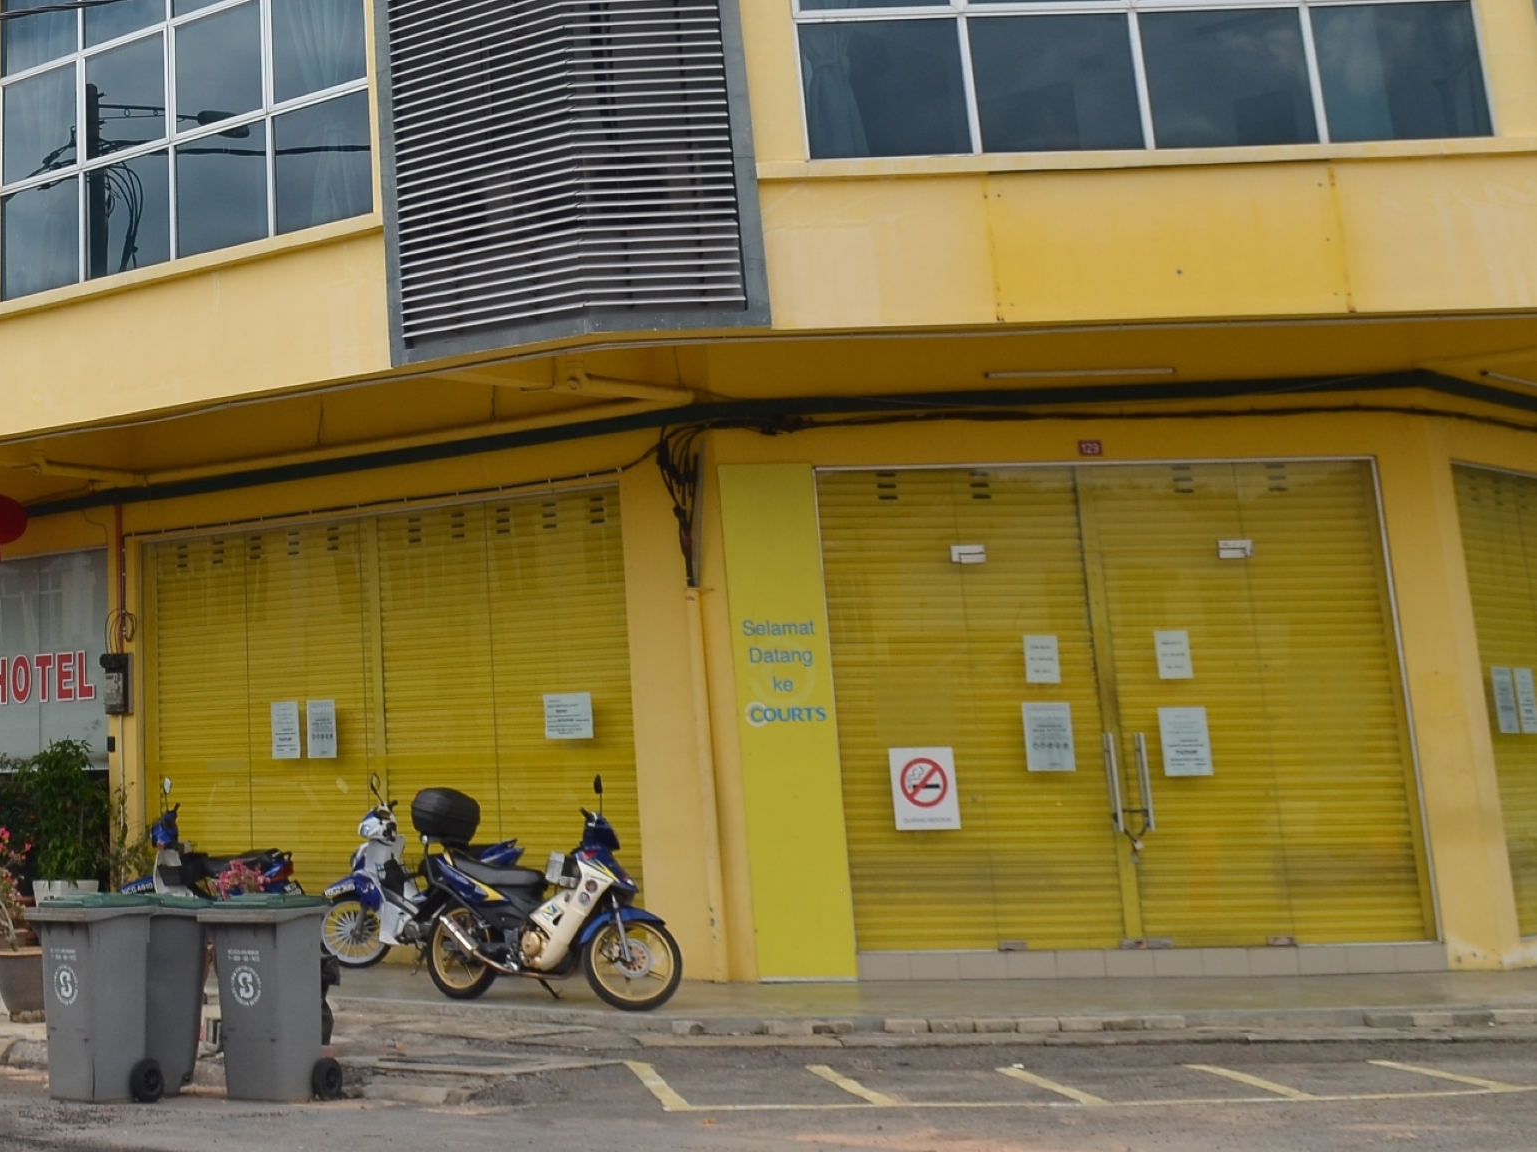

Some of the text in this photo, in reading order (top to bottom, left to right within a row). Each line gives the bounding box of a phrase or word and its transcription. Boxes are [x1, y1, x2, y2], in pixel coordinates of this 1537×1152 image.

[742, 619, 815, 636] Selamat
[749, 648, 813, 667] Datang
[773, 676, 794, 692] ke
[750, 706, 827, 723] COURTS
